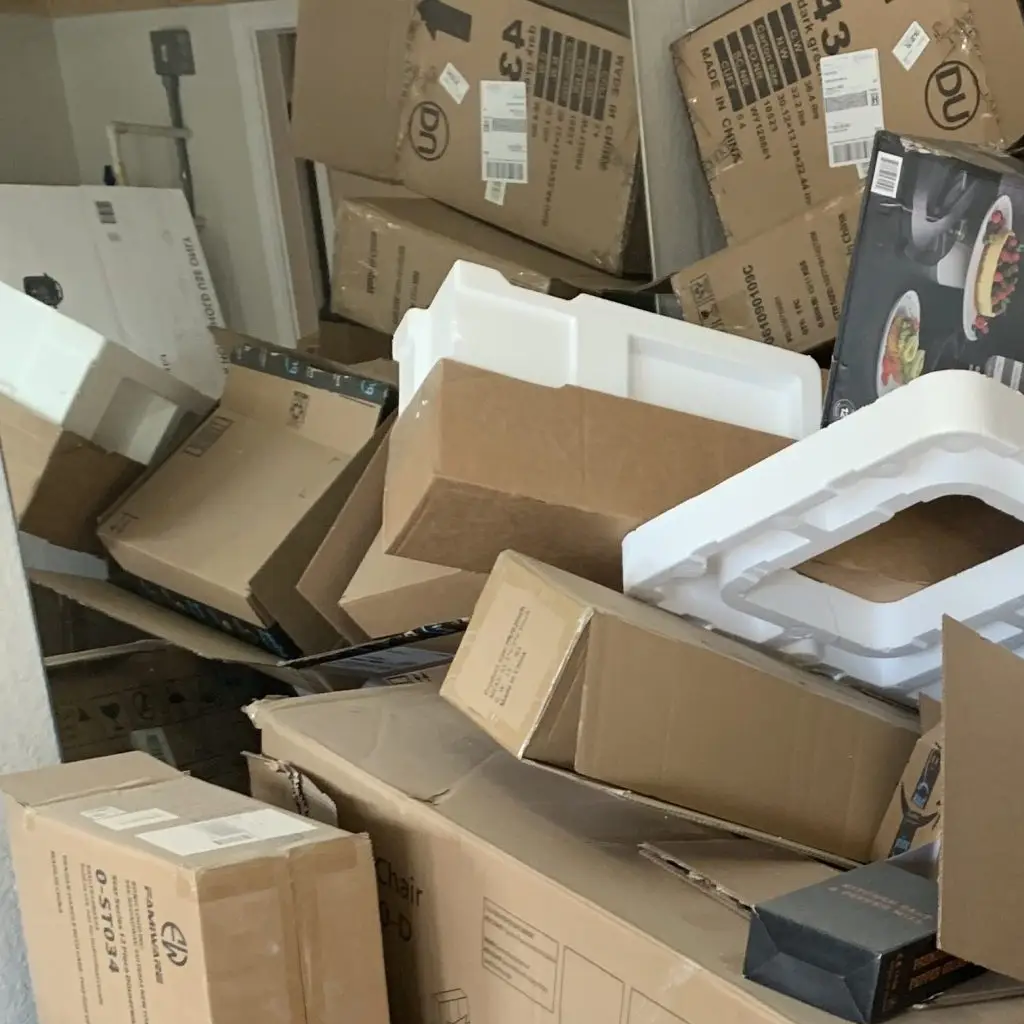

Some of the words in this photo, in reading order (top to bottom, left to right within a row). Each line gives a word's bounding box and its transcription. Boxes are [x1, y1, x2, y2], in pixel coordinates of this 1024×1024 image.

[809, 0, 857, 57] 43
[700, 45, 721, 90] MADE
[714, 95, 727, 112] IN
[933, 65, 972, 124] DU
[377, 859, 424, 907] Chair
